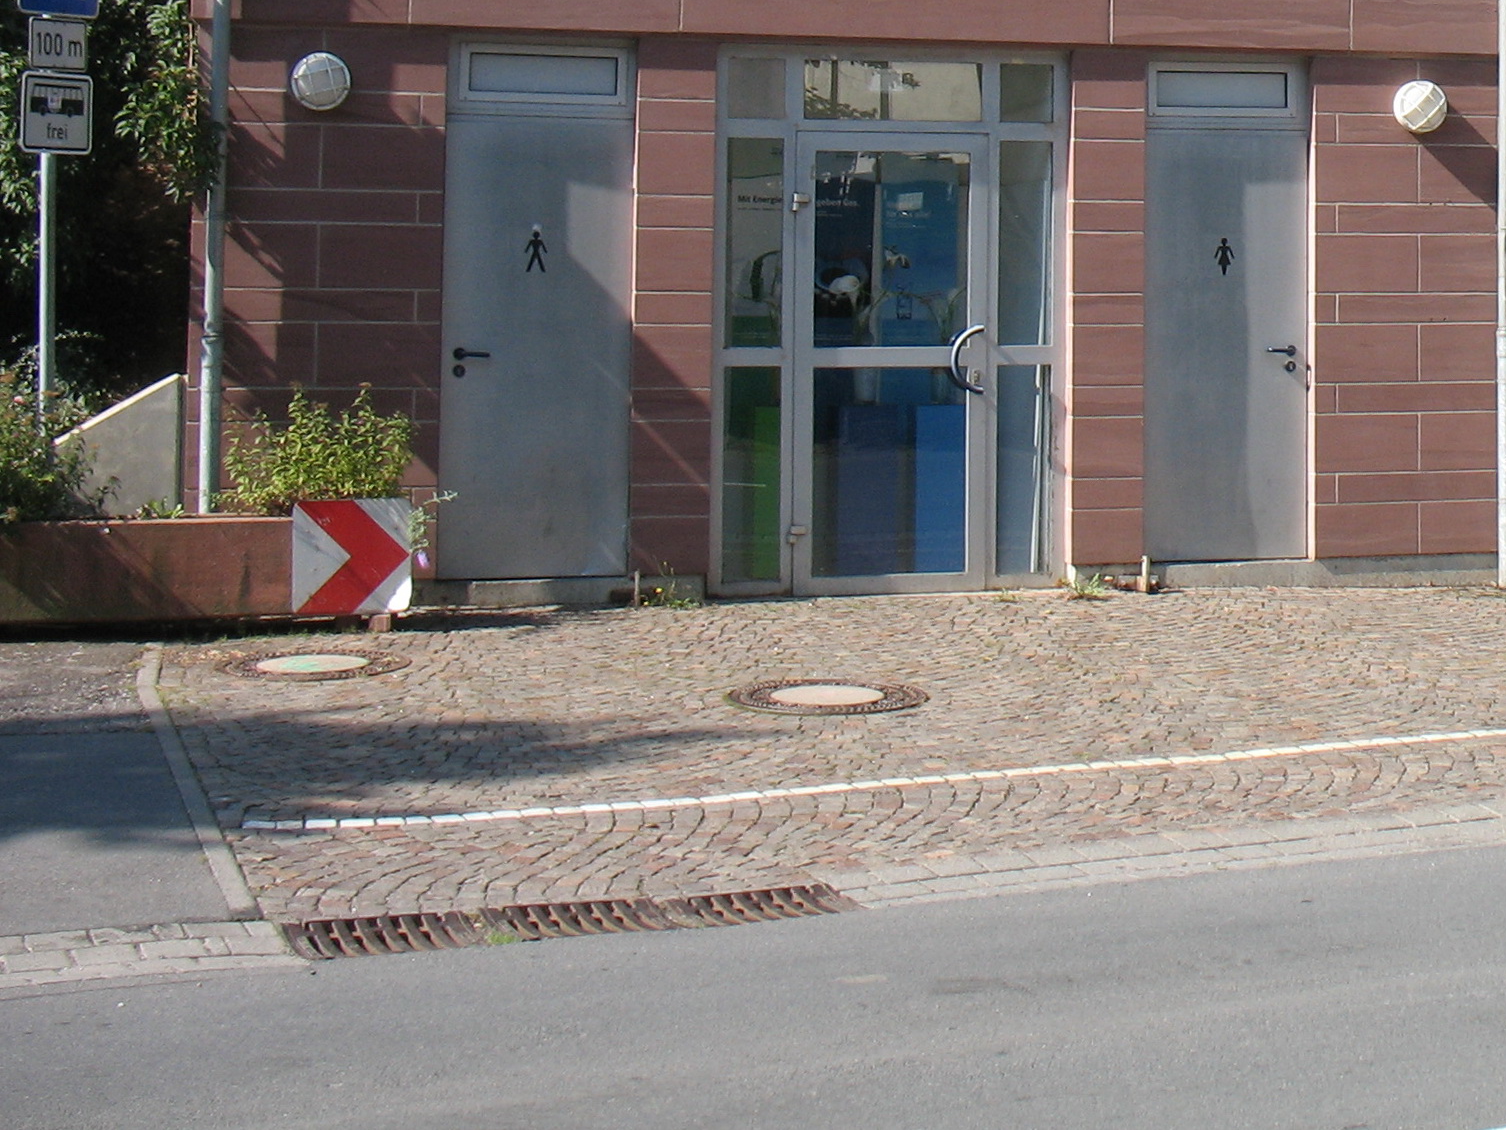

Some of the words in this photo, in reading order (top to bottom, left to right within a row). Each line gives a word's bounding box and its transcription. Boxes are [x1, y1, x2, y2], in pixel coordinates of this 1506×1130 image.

[36, 31, 62, 56] 100
[68, 40, 82, 58] m
[46, 122, 68, 141] frei
